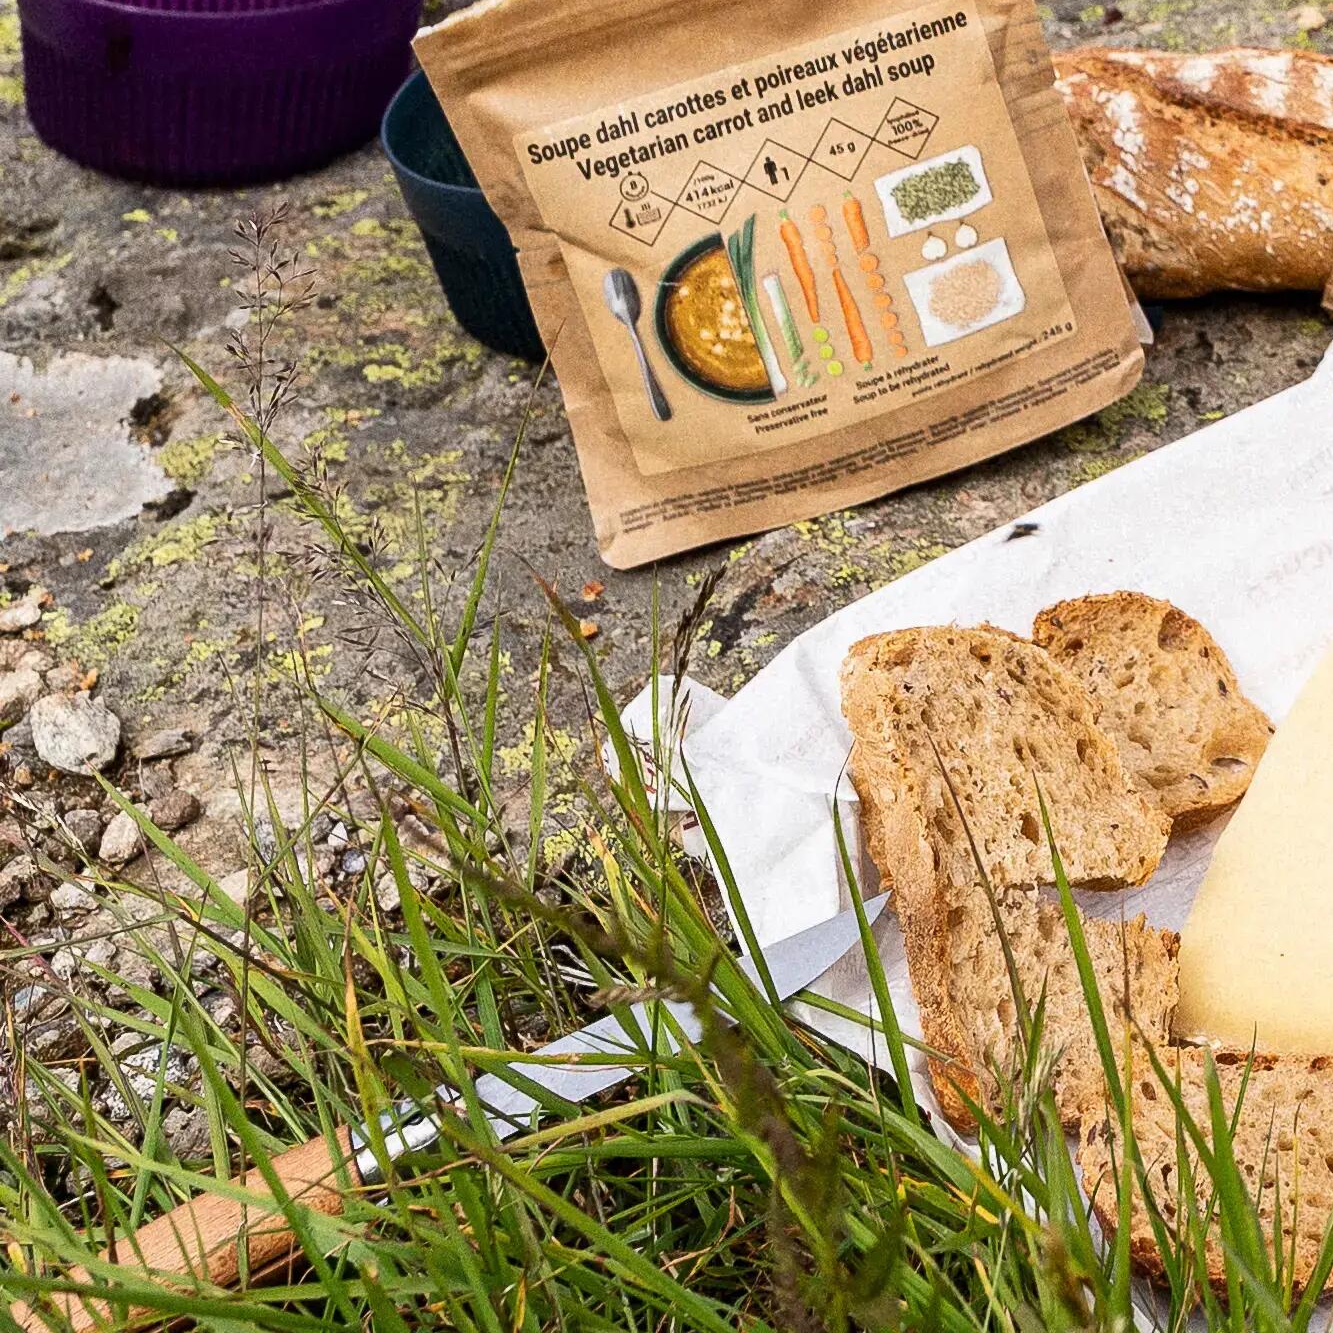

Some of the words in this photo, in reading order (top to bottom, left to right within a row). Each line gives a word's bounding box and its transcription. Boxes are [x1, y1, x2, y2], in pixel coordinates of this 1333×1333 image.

[527, 133, 592, 165] Soupe
[596, 111, 640, 144] dahl
[644, 89, 727, 129] carottes
[731, 78, 753, 101] et
[755, 53, 839, 99] poireaux
[842, 11, 968, 63] végétarienne
[576, 133, 689, 181] Vegetarian
[693, 108, 754, 144] carrot
[757, 93, 794, 124] and
[796, 80, 840, 111] leek
[842, 64, 884, 96] dahl
[887, 53, 935, 83] soup
[891, 118, 923, 135] 100%
[829, 143, 845, 156] 45
[848, 141, 856, 153] g
[781, 166, 790, 180] 1
[1065, 321, 1073, 332] g
[853, 391, 877, 404] Soup
[879, 387, 888, 396] to
[889, 381, 900, 392] be
[902, 363, 950, 387] rehydrated
[856, 375, 884, 390] Soupe
[755, 412, 809, 434] Preservative
[810, 406, 828, 418] free
